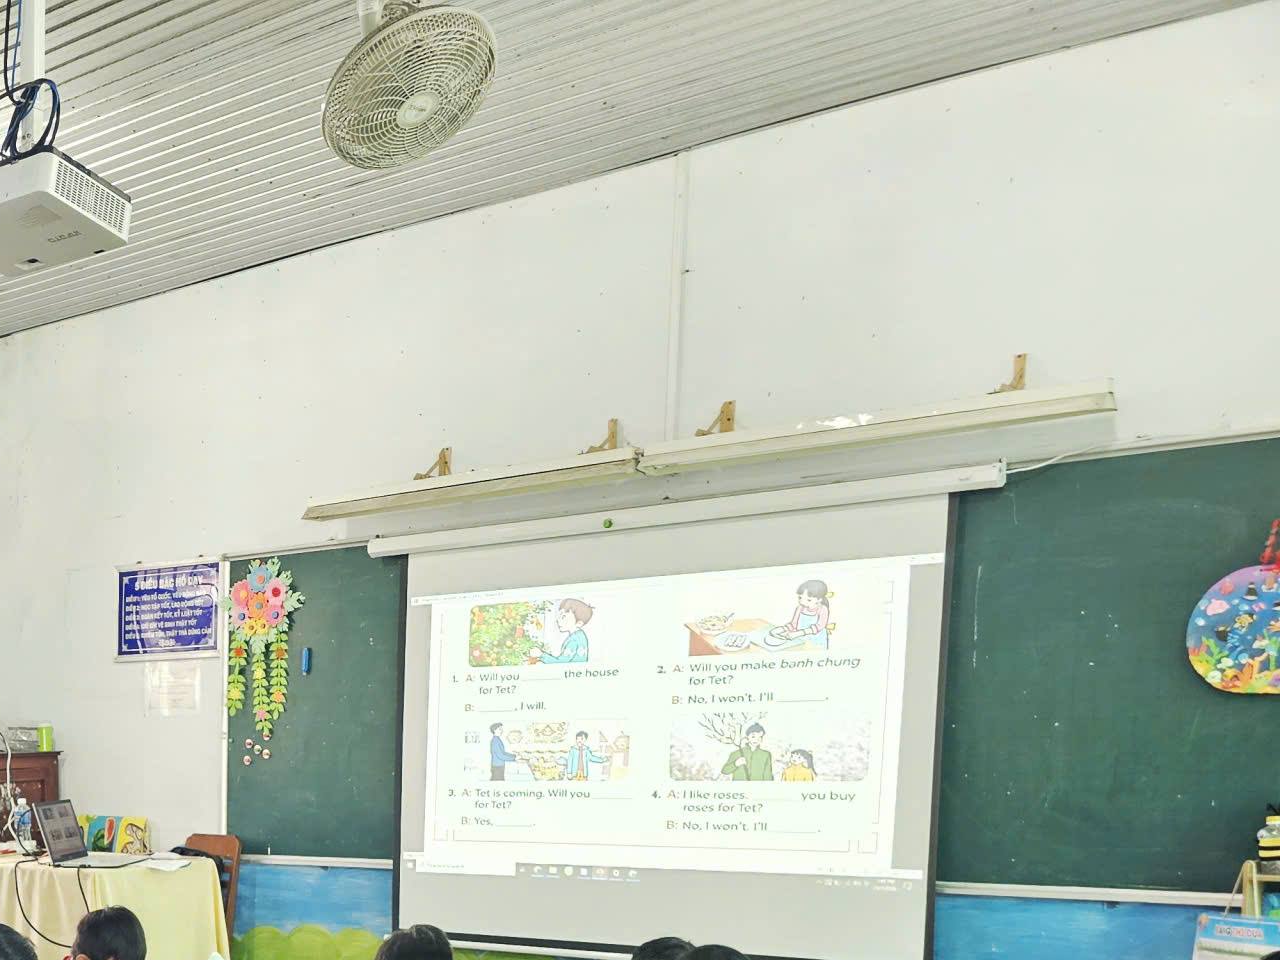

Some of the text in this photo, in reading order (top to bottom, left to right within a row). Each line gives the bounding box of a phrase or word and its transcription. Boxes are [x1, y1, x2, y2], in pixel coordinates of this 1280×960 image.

[672, 664, 684, 673] A:
[689, 663, 712, 672] Will
[715, 663, 738, 674] you
[741, 660, 776, 671] make
[780, 658, 814, 669] banh
[817, 656, 861, 669] chung
[479, 673, 498, 682] Will
[500, 674, 520, 683] you
[564, 670, 583, 679] the
[585, 668, 619, 677] house
[689, 675, 734, 686] for Tet?
[479, 685, 517, 695] for Tet?
[672, 695, 683, 705] B:
[687, 694, 708, 705] No,
[718, 692, 755, 703] won't.
[759, 691, 773, 702] I'll
[464, 703, 474, 712] B:
[526, 701, 546, 711] will.
[461, 788, 472, 797] A:
[476, 788, 490, 797] Tet
[493, 788, 501, 797] is
[503, 788, 545, 799] coming.
[548, 788, 567, 797] Will
[570, 790, 590, 800] you
[651, 790, 661, 799] 4.
[667, 790, 680, 799] A:
[689, 790, 710, 799] like
[713, 791, 749, 800] roses.
[801, 792, 826, 801] you
[830, 791, 856, 801] buy
[475, 800, 512, 809] for Tet?
[683, 803, 763, 813] roses for Tet?
[461, 816, 494, 827] B: Yes,
[666, 820, 679, 830] B:
[682, 821, 702, 831] No,
[754, 821, 768, 831] I'll
